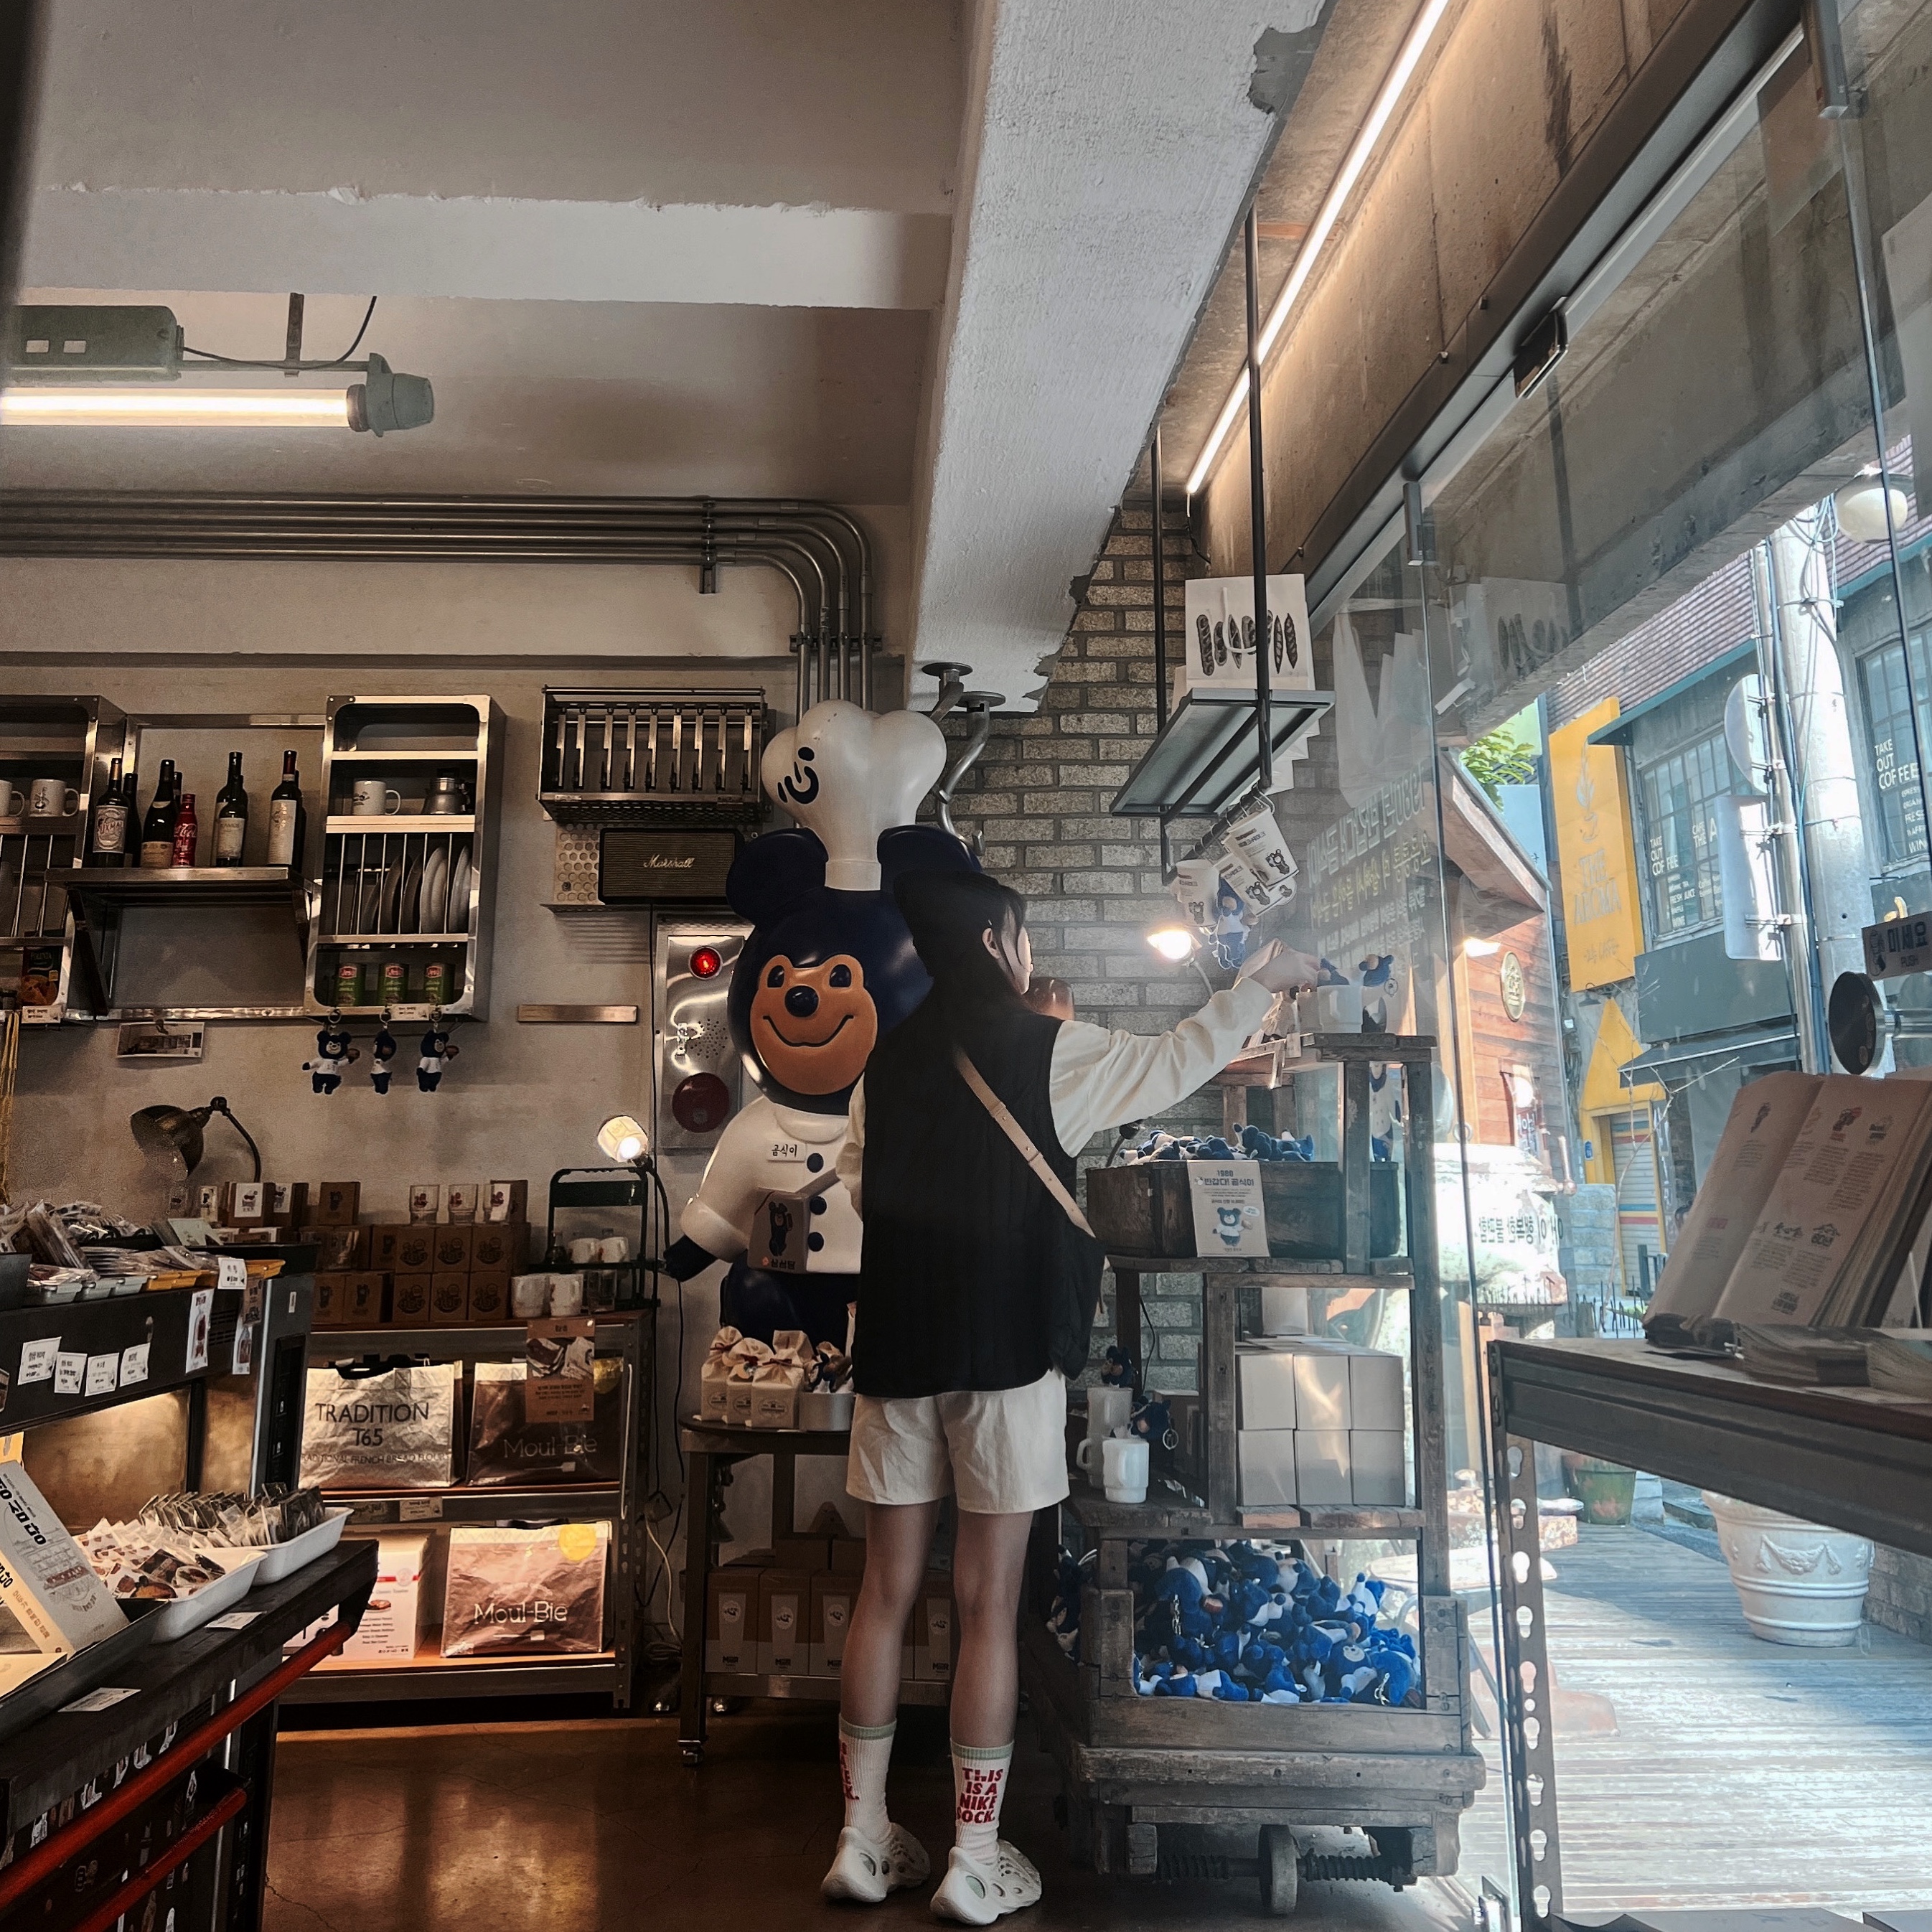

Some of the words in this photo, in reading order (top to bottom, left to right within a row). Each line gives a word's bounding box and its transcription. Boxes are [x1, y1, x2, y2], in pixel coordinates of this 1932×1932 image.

[1875, 739, 1893, 756] TAKE
[1876, 753, 1894, 772] OUT
[643, 854, 695, 868] Marshall
[1651, 848, 1663, 862] OUT
[1580, 848, 1608, 888] THE
[1575, 878, 1622, 925] AROMA
[772, 1143, 797, 1157] 곰식이
[315, 1402, 429, 1423] TRADITION
[352, 1427, 383, 1446] T65
[504, 1435, 597, 1458] Moul-Bie
[474, 1600, 568, 1624] Moul-Bie
[962, 1767, 1003, 1782] THIS
[966, 1781, 983, 1794] IS
[985, 1783, 997, 1795] A
[960, 1793, 998, 1810] NIKE
